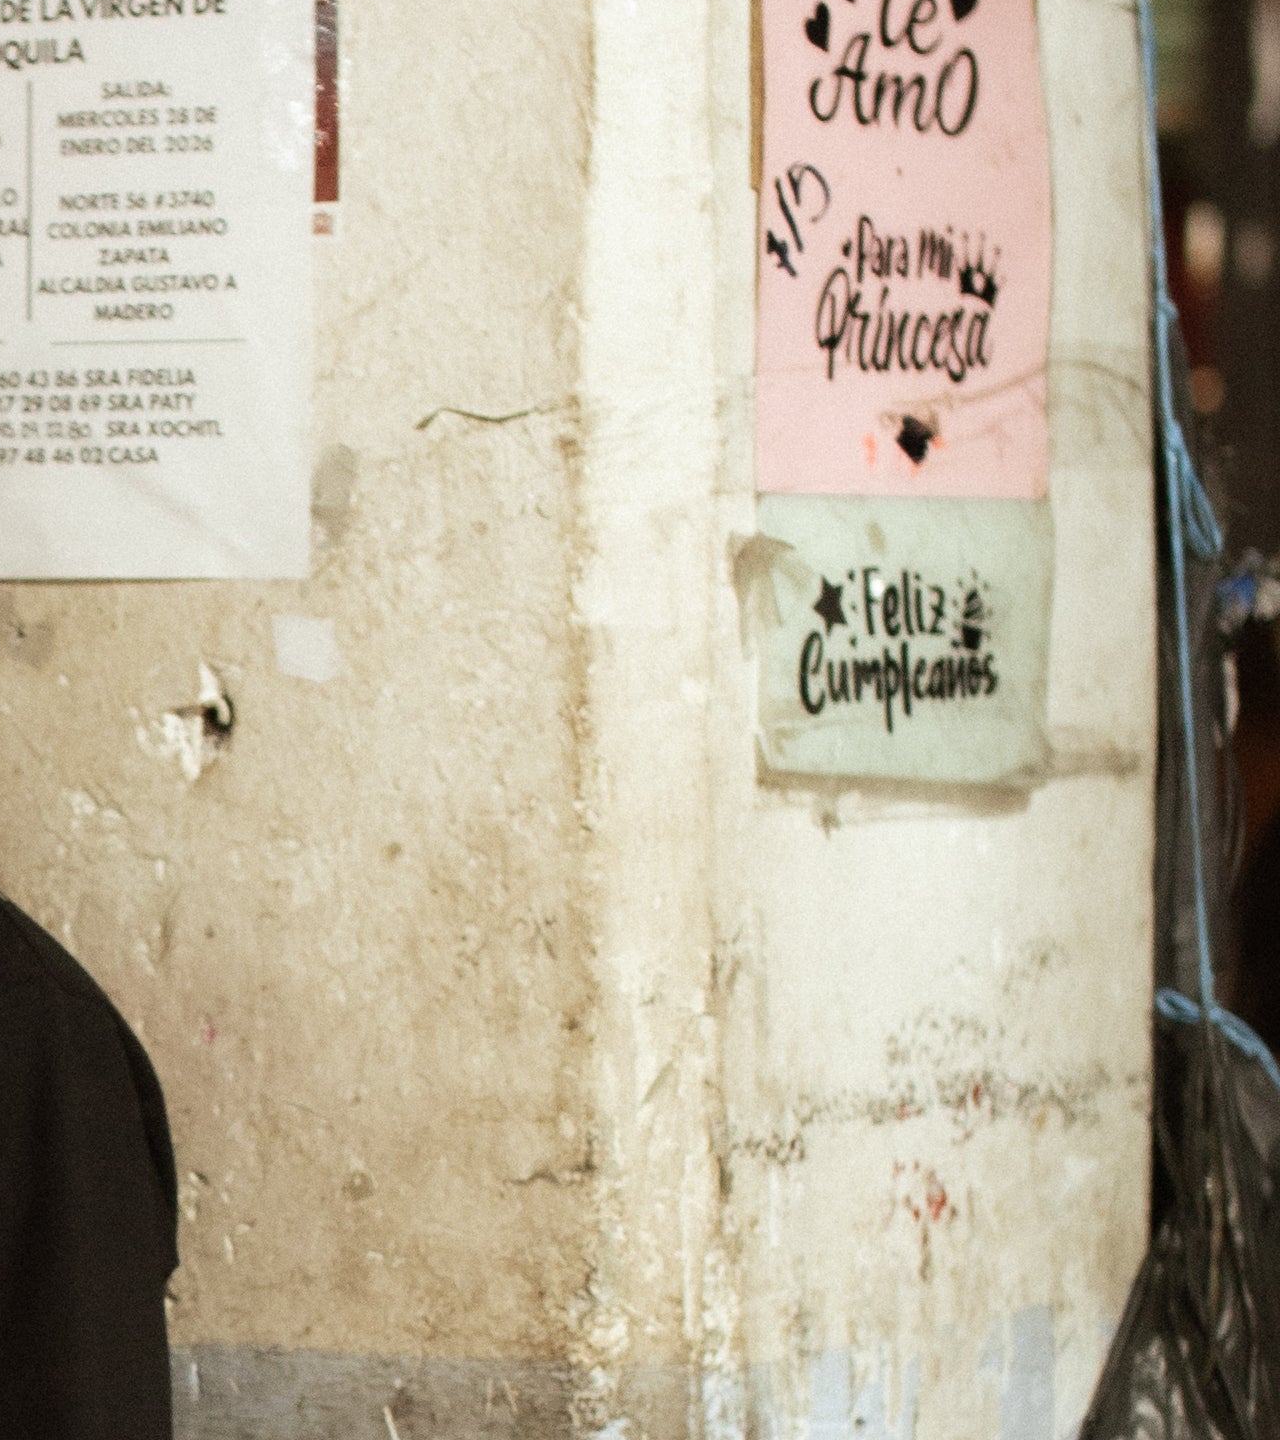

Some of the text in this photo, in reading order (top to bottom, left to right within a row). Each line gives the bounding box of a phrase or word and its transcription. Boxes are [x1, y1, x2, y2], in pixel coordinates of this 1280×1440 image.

[193, 105, 218, 125] DE
[59, 137, 122, 156] ENERO
[126, 135, 157, 154] DEL
[59, 192, 120, 211] NORTE
[47, 217, 228, 240] COLONIA EMILIANO
[98, 247, 170, 266] ZAPATA
[856, 213, 908, 284] Para
[131, 274, 219, 293] GUSTAVO
[225, 272, 238, 290] A
[94, 302, 175, 321] MADERO
[816, 267, 989, 382] Princesa
[85, 369, 122, 388] SRA
[107, 393, 143, 411] SRA
[148, 392, 195, 411] PATY
[105, 420, 141, 438] SRA
[107, 445, 159, 463] CASA
[861, 566, 945, 637] Feliz
